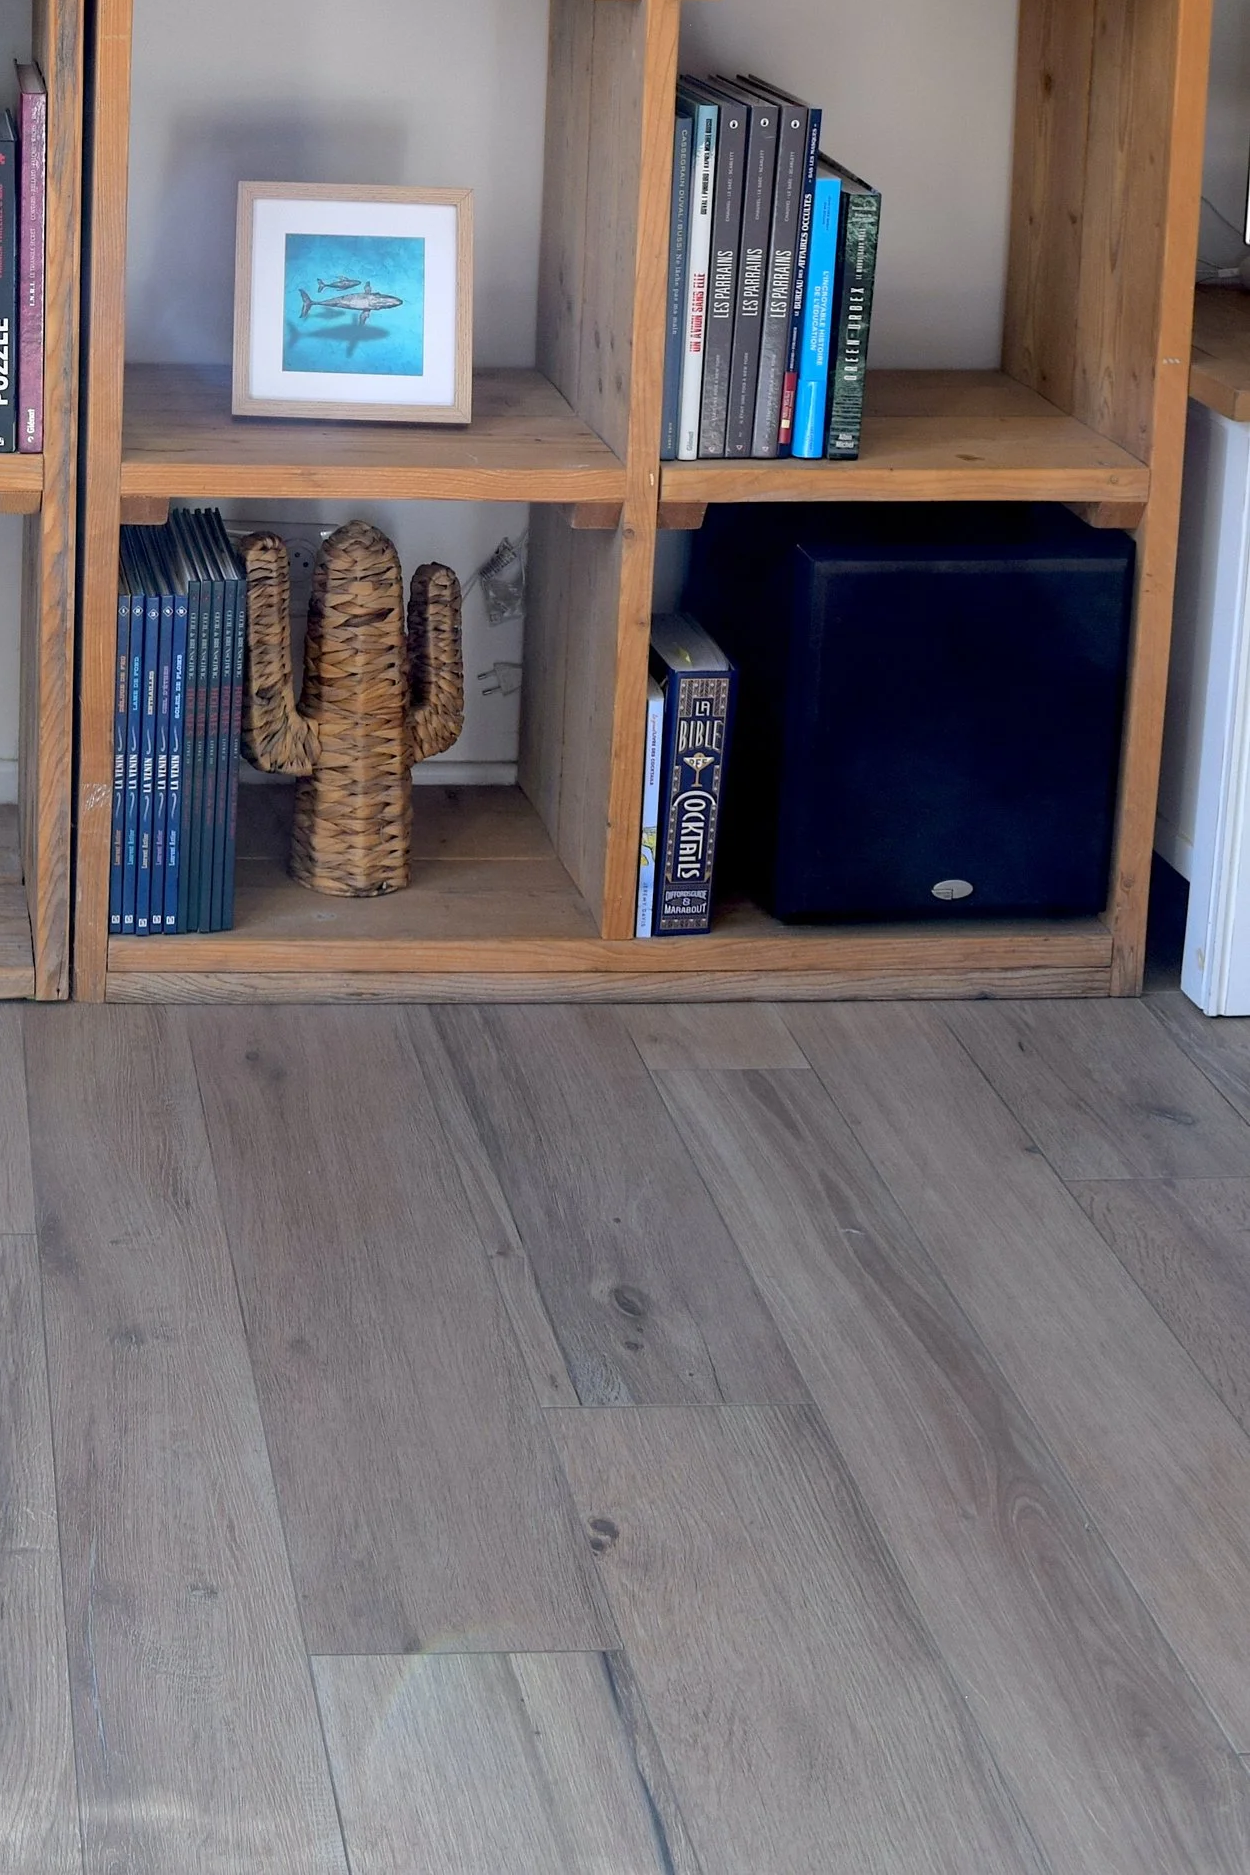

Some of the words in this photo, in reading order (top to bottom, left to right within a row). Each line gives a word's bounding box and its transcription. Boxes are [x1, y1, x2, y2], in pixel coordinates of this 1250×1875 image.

[679, 128, 689, 188] CASSEGRAIN
[802, 194, 813, 232] OCCULTES
[797, 233, 810, 269] AFFAIRES
[693, 272, 706, 289] ELLE
[716, 251, 733, 298] PARRAINS
[744, 249, 762, 296] PARRAINS
[773, 251, 791, 298] PARRAINS
[691, 290, 704, 313] SANS
[795, 279, 804, 310] BUREAU
[814, 285, 821, 299] DE
[818, 270, 829, 328] L'INCROYABLE
[714, 302, 729, 319] LES
[742, 300, 758, 317] LES
[770, 302, 787, 319] LES
[847, 287, 864, 330] URBEX
[690, 314, 702, 339] AVION
[809, 301, 821, 351] L'ÉDUCATION
[689, 340, 701, 353] UN
[816, 329, 825, 366] HISTOIRE
[843, 338, 859, 381] GREEN
[25, 408, 36, 434] Glénat
[175, 654, 183, 680] PLOMB
[147, 670, 155, 716] ENTRAILLES
[175, 681, 181, 692] DE
[695, 699, 711, 716] LA
[678, 720, 724, 752] BIBLE
[115, 755, 124, 778] VENIN
[129, 755, 138, 778] VENIN
[143, 758, 152, 781] VENIN
[157, 755, 166, 778] VENIN
[170, 755, 179, 778] VENIN
[649, 759, 657, 786] COCKTAILS
[688, 757, 708, 768] DES
[114, 781, 123, 790] LA
[128, 781, 137, 790] LA
[142, 784, 151, 793] LA
[156, 781, 165, 790] LA
[169, 781, 178, 790] LA
[673, 789, 717, 880] COCKTAILS
[663, 902, 707, 914] MARABOUT
